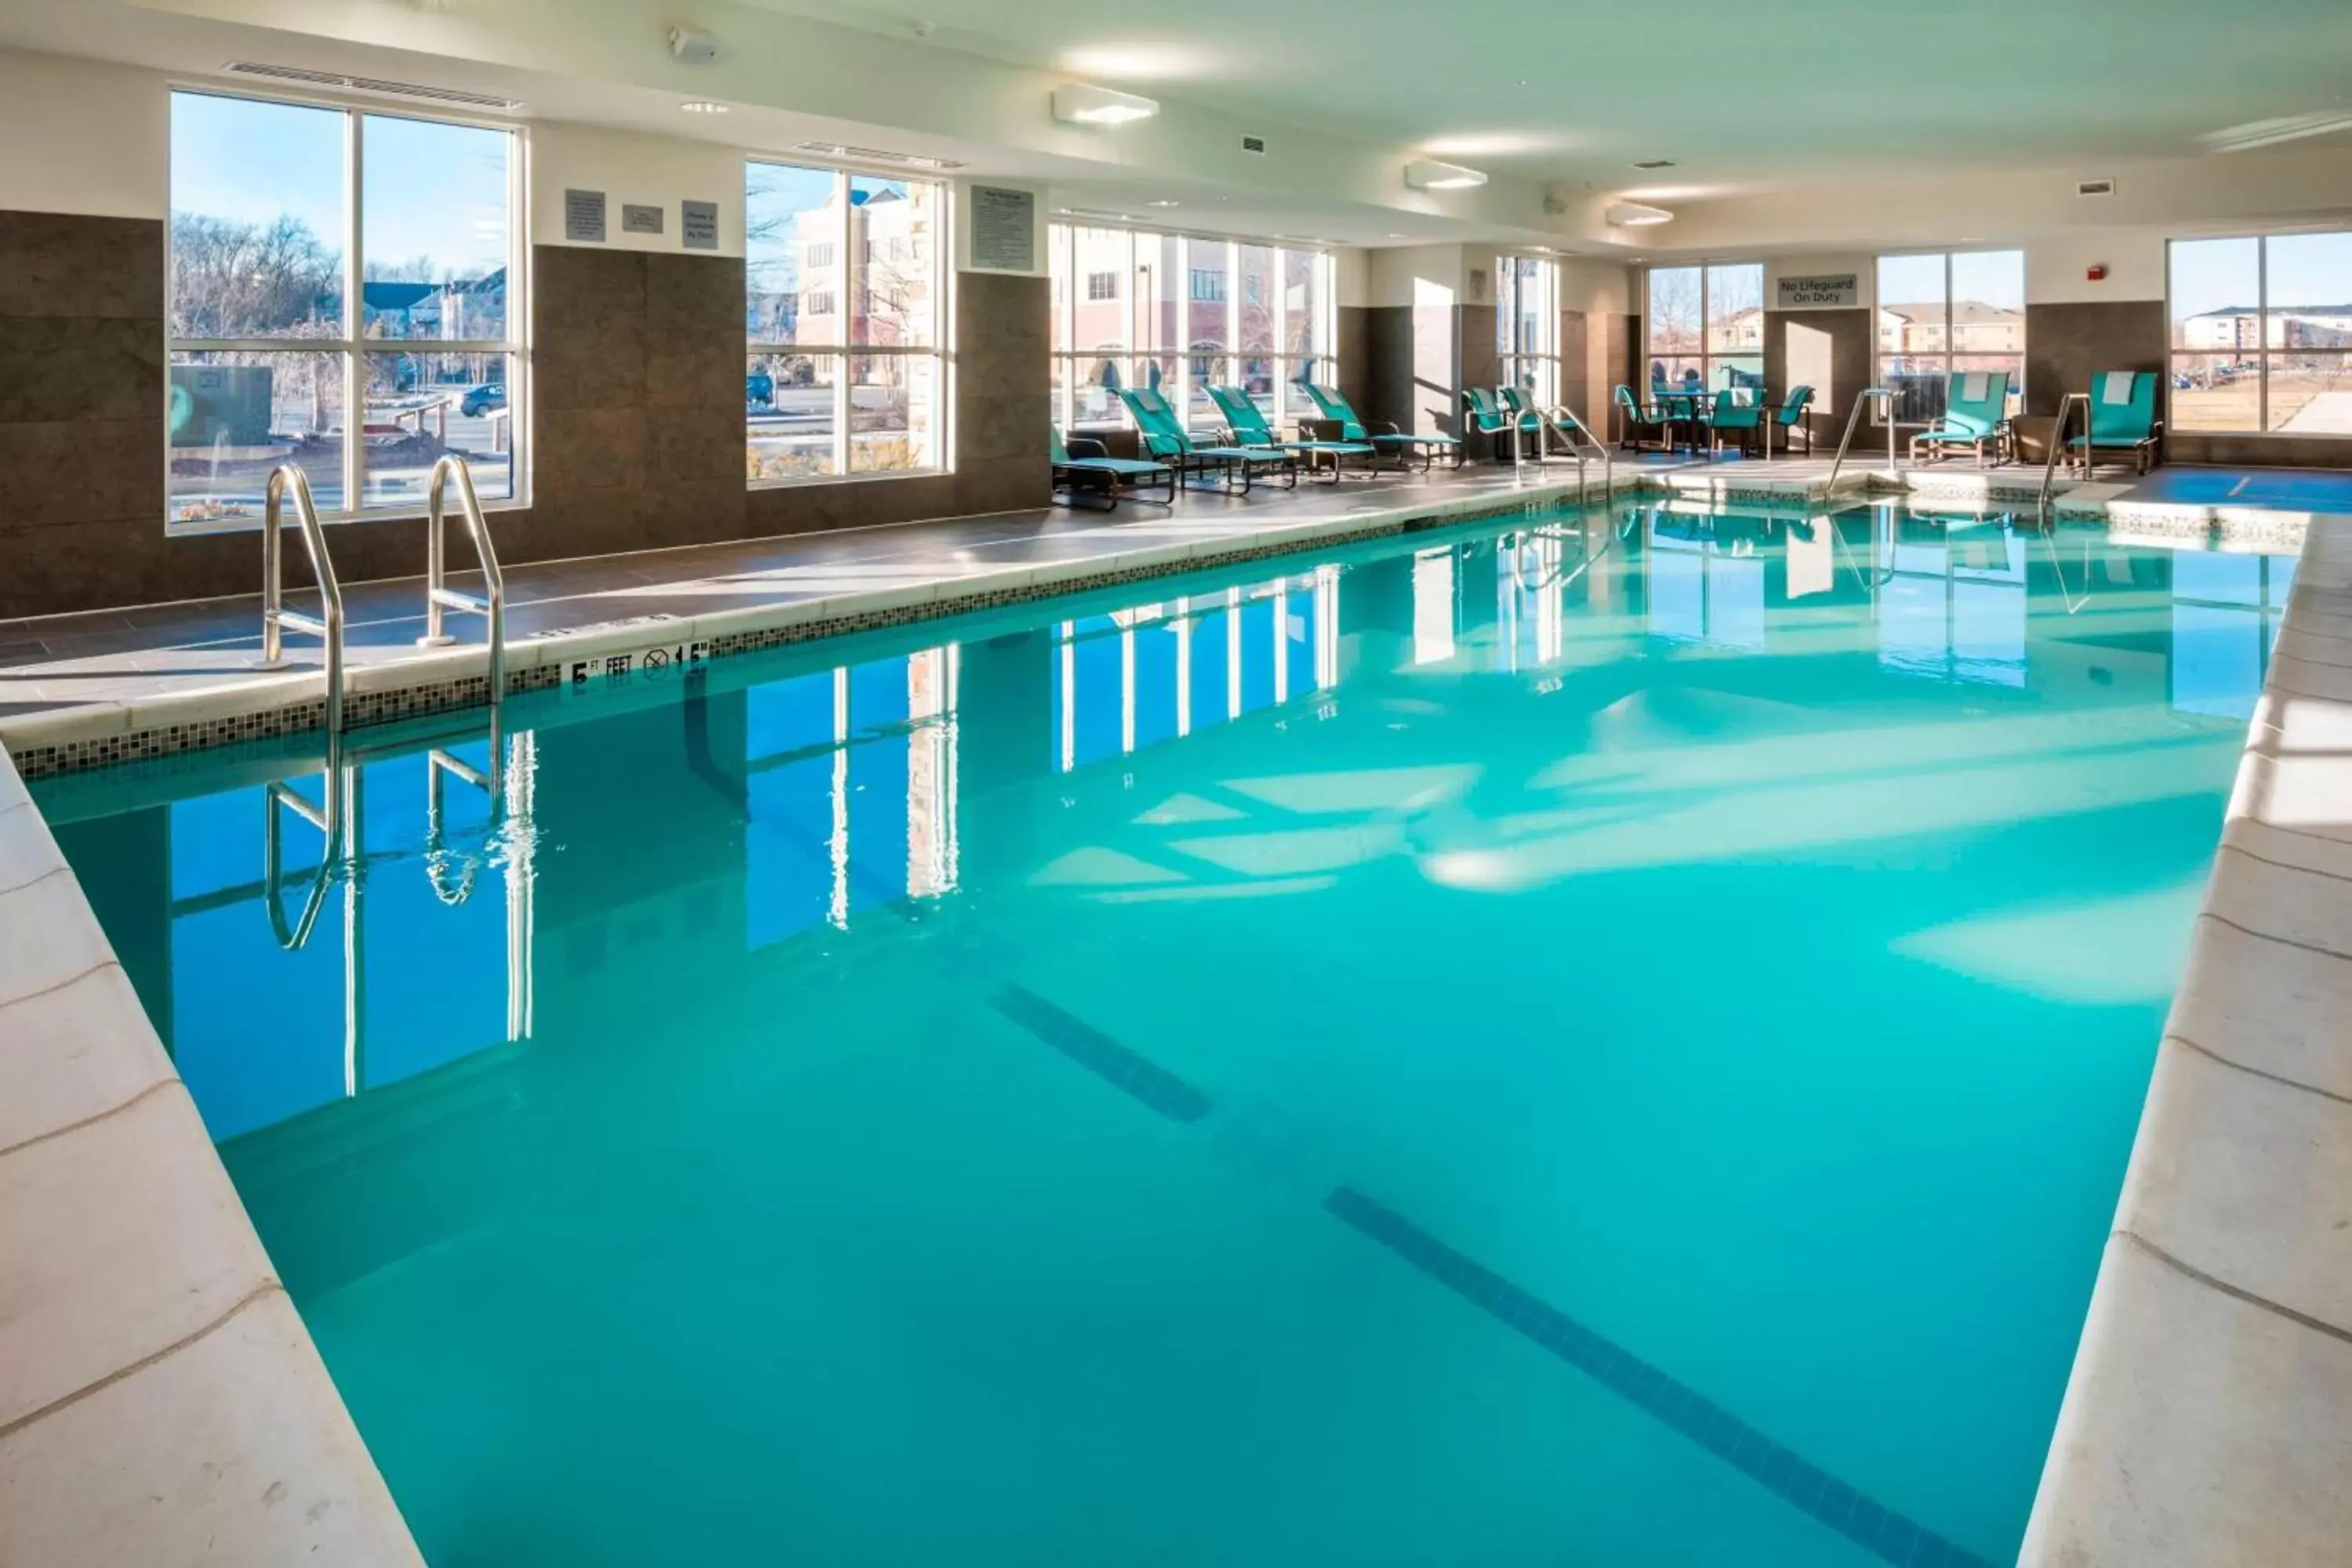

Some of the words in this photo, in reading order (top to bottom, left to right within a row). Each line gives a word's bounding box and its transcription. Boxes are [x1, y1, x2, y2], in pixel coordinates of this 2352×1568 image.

[1781, 281, 1796, 291] No
[1800, 279, 1853, 292] Lifeguard
[1793, 293, 1810, 303] On
[1813, 292, 1840, 303] Duty
[572, 662, 587, 684] 5
[607, 655, 632, 676] FEET
